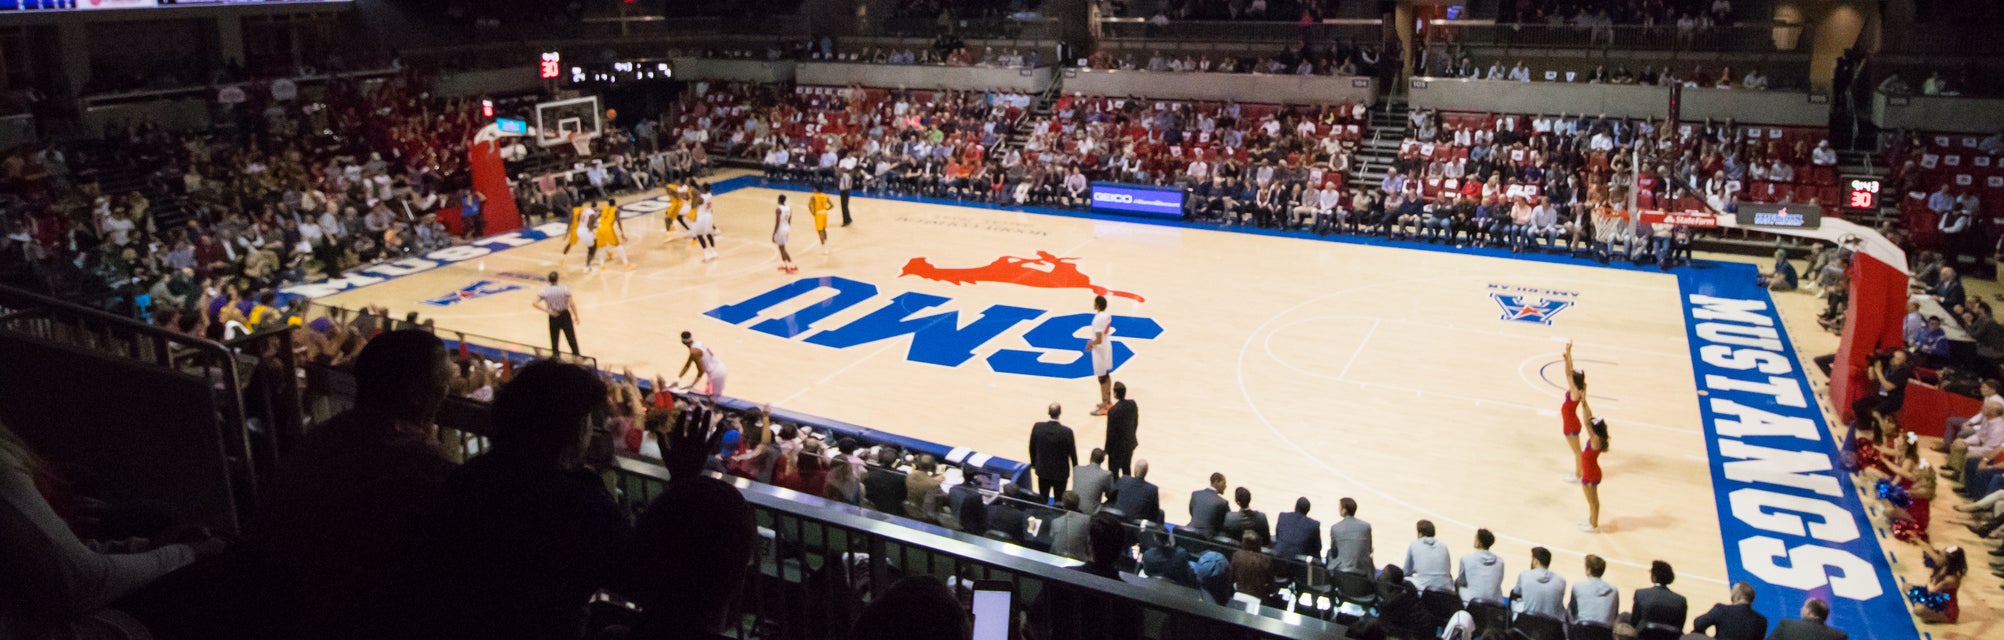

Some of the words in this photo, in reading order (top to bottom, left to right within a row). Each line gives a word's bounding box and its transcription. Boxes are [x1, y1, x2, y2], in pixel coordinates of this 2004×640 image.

[541, 61, 559, 78] 30
[1093, 191, 1133, 204] GEICO
[1850, 190, 1872, 208] 30
[701, 275, 1165, 379] SMU
[1689, 293, 1884, 601] MUSTANGS
